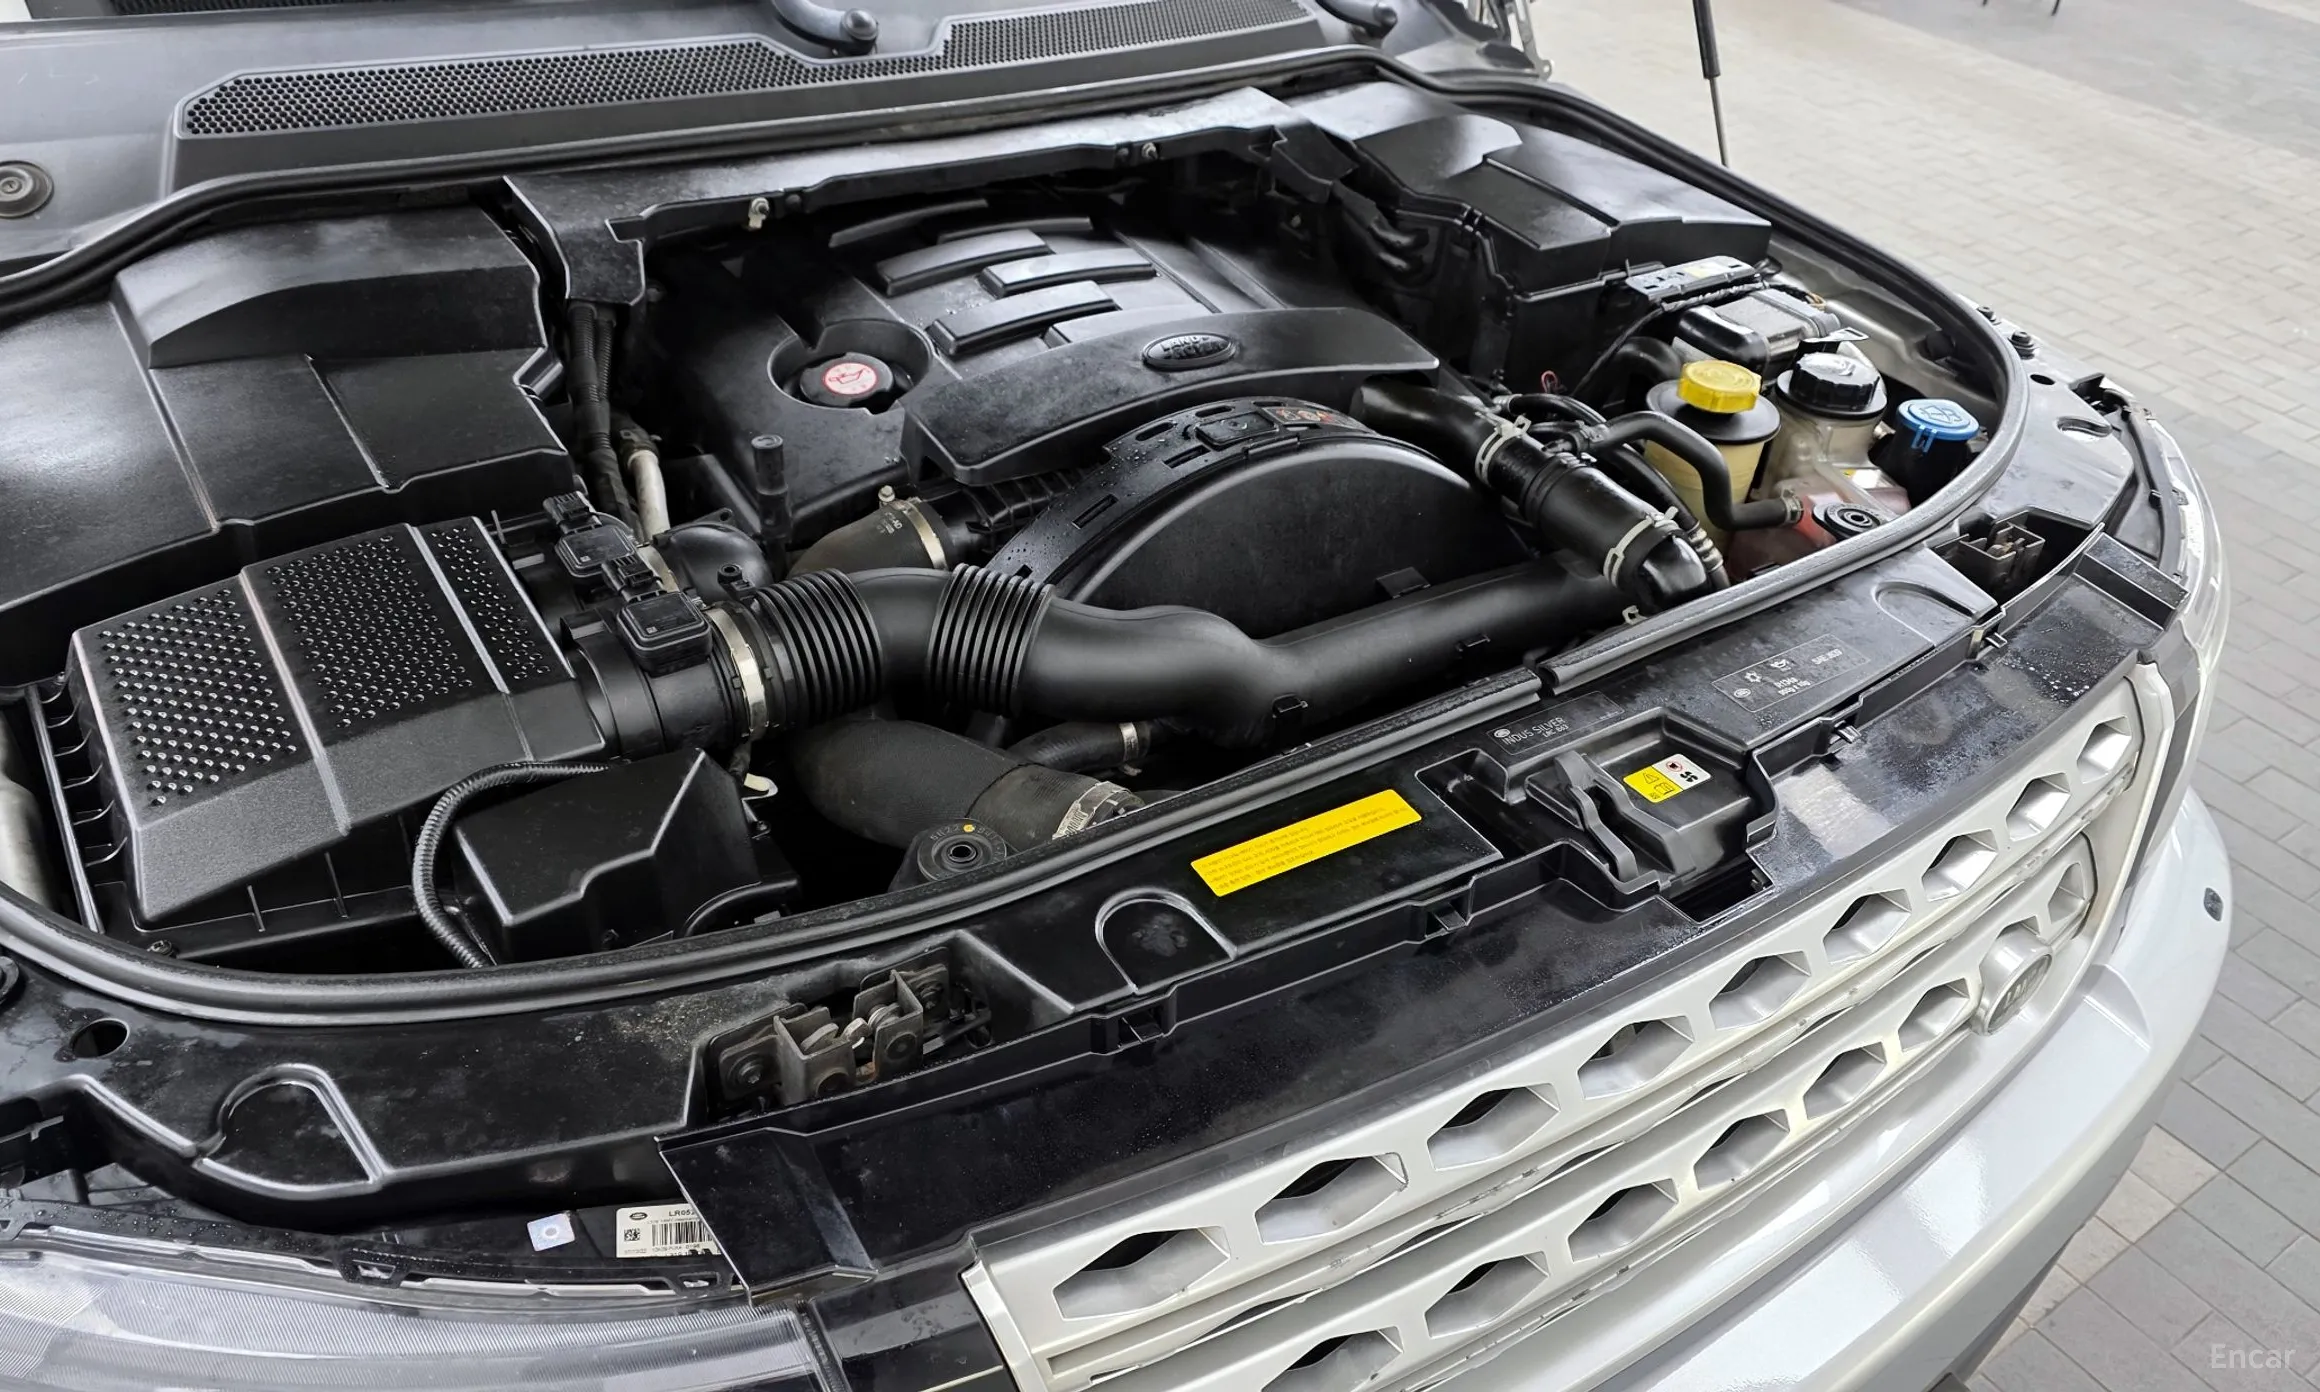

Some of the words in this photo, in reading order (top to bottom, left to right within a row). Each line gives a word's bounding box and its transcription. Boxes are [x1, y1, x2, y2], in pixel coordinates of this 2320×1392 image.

[1160, 335, 1210, 352] LAND
[1502, 729, 1535, 746] INDUS
[1532, 717, 1567, 735] SILVER
